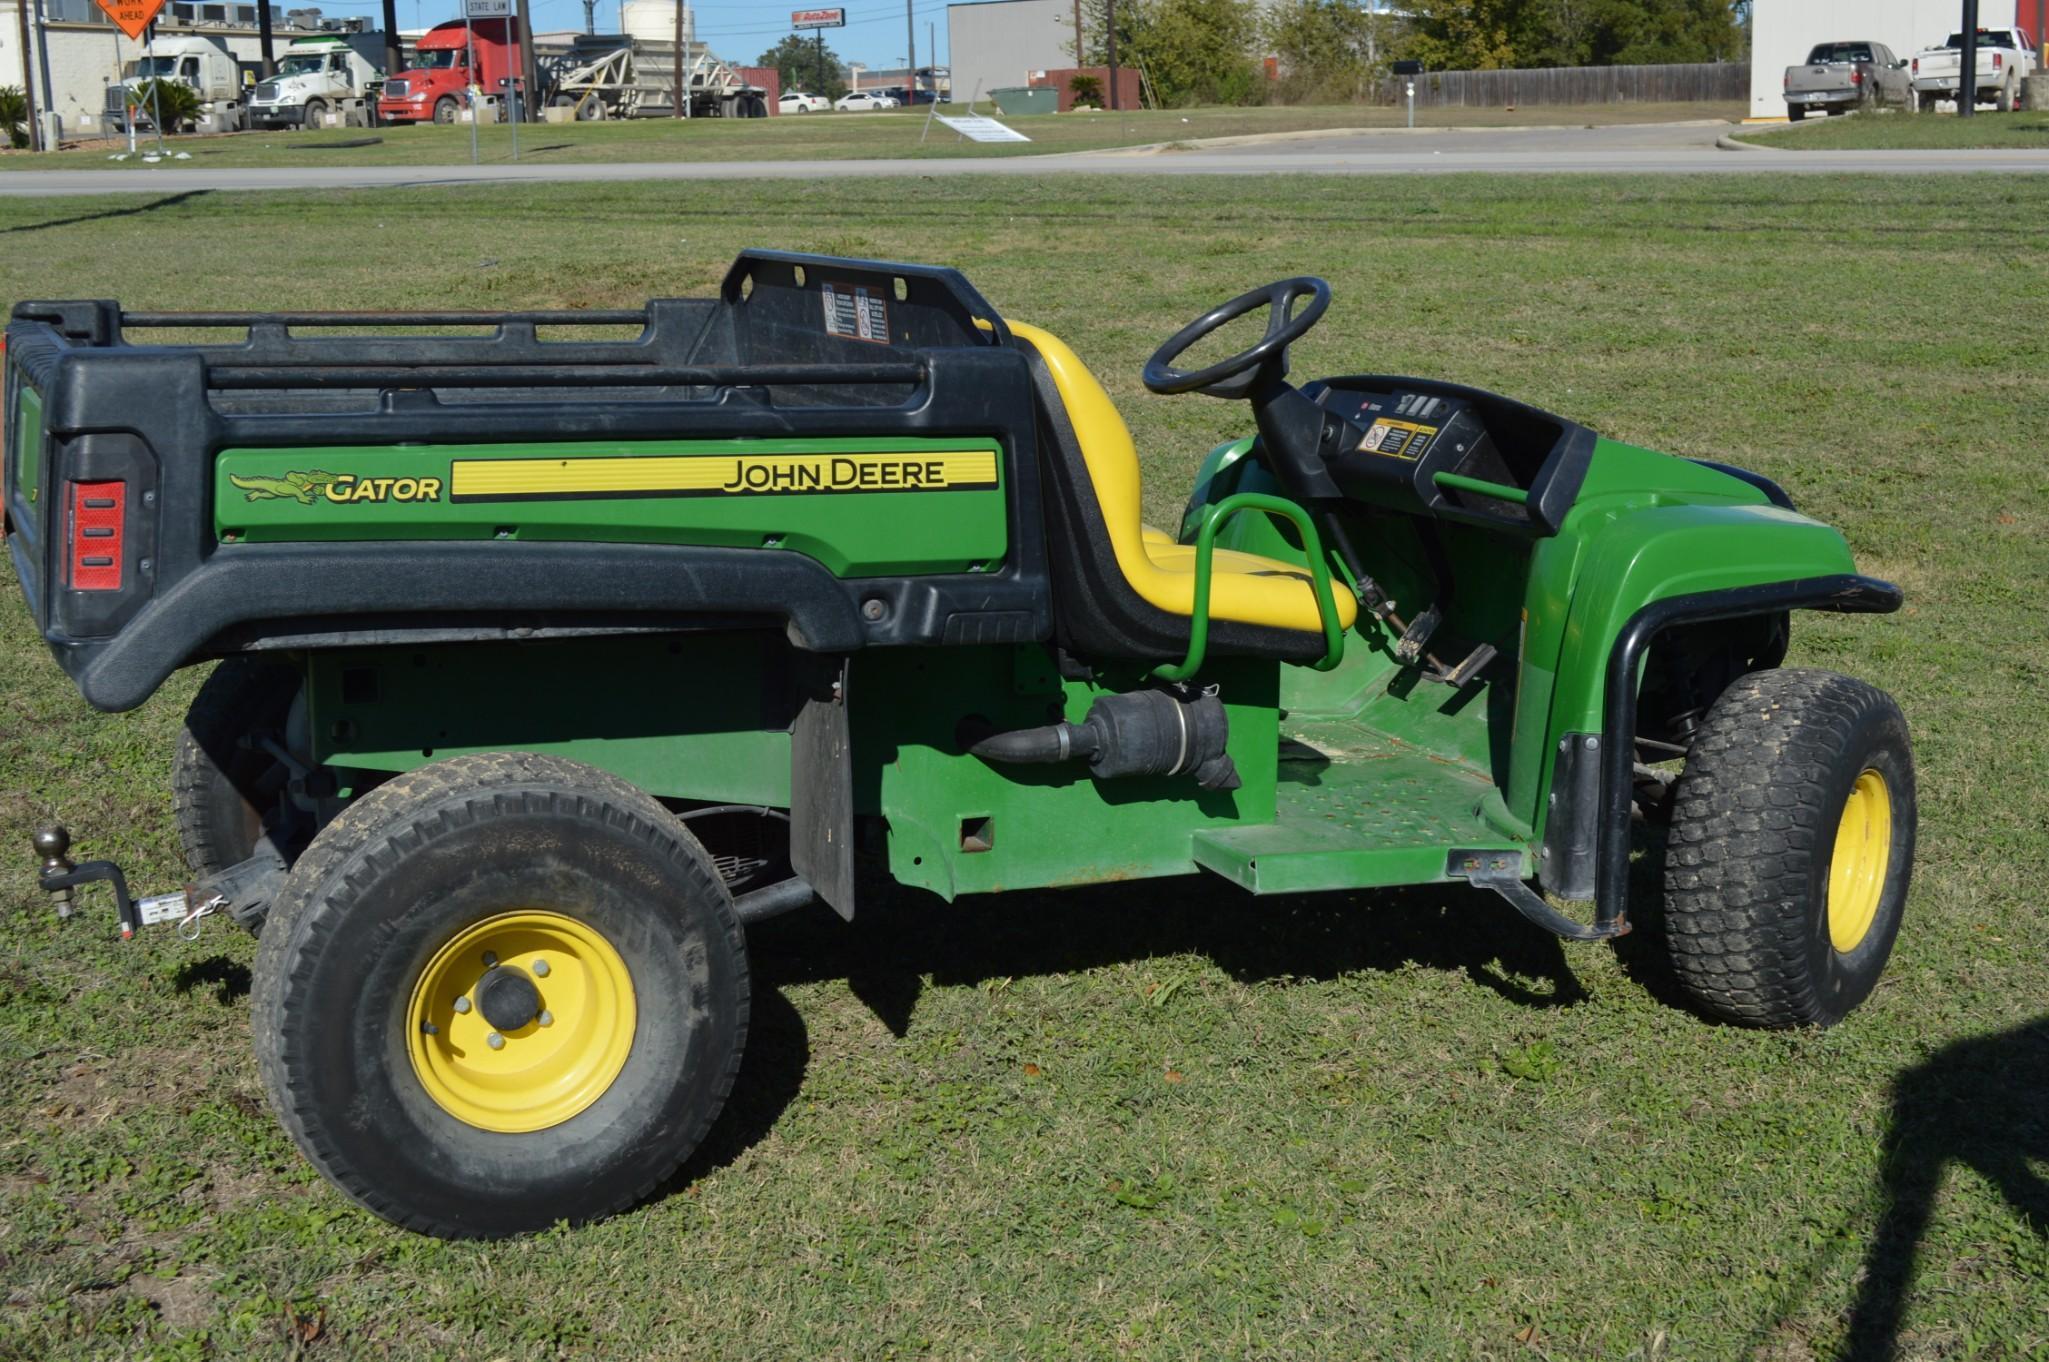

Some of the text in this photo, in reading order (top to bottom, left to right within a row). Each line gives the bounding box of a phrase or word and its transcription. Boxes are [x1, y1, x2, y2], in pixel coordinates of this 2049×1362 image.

[120, 10, 144, 20] AHEAD
[471, 2, 507, 11] STATE LAW
[724, 458, 945, 488] JOHN DEERE
[324, 475, 442, 502] GATOR
